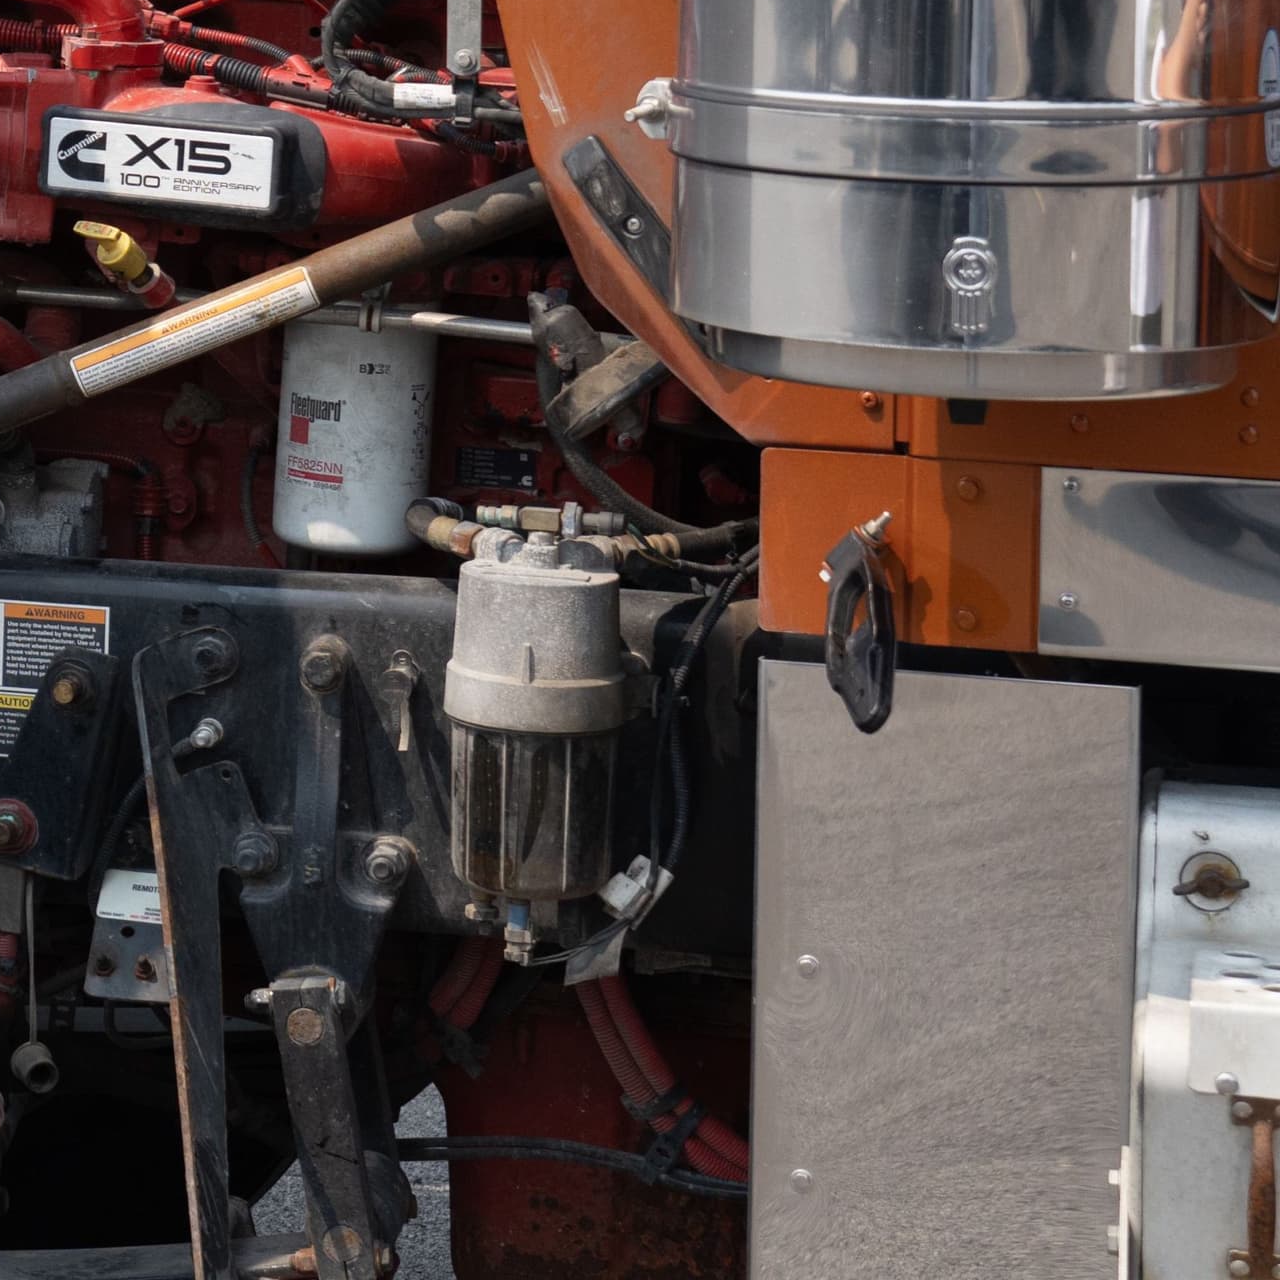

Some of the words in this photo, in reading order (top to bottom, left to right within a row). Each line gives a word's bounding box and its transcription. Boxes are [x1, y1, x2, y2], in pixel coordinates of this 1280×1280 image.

[57, 132, 103, 160] Cummins
[122, 134, 232, 176] X15
[172, 186, 221, 195] EDITION
[173, 177, 262, 192] ANNIVERSARY
[168, 308, 218, 330] WARNING
[290, 391, 341, 423] Fleetguard
[287, 455, 343, 474] FF5825NN
[34, 608, 86, 620] WARNING
[132, 883, 160, 893] REMOT
